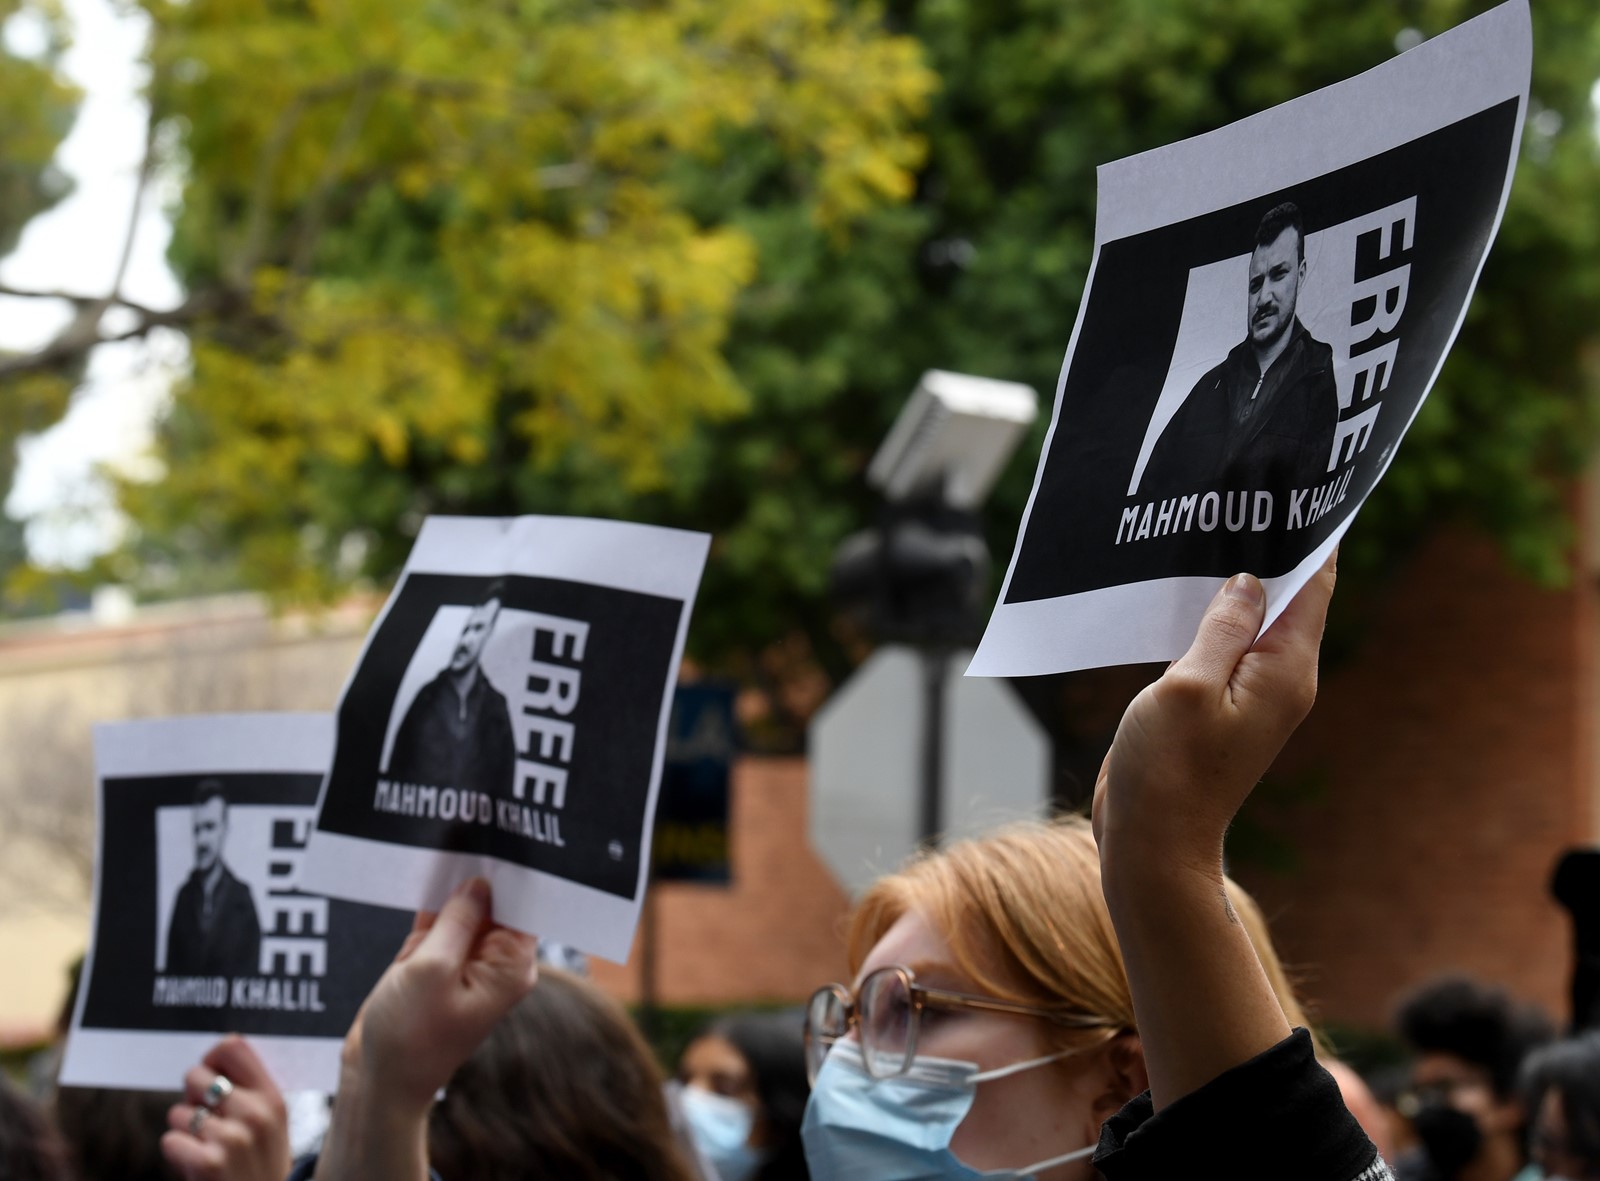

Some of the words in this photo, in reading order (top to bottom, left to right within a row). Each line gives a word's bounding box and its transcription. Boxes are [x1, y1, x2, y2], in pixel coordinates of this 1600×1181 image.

[1326, 194, 1418, 473] FREE
[1115, 490, 1273, 545] MAHMOUD
[1286, 465, 1356, 530] KHALIL
[513, 613, 591, 809] FREE
[374, 779, 493, 825] MAHMOUD
[496, 797, 566, 847] KHALIL
[231, 976, 326, 1012] KHALIL
